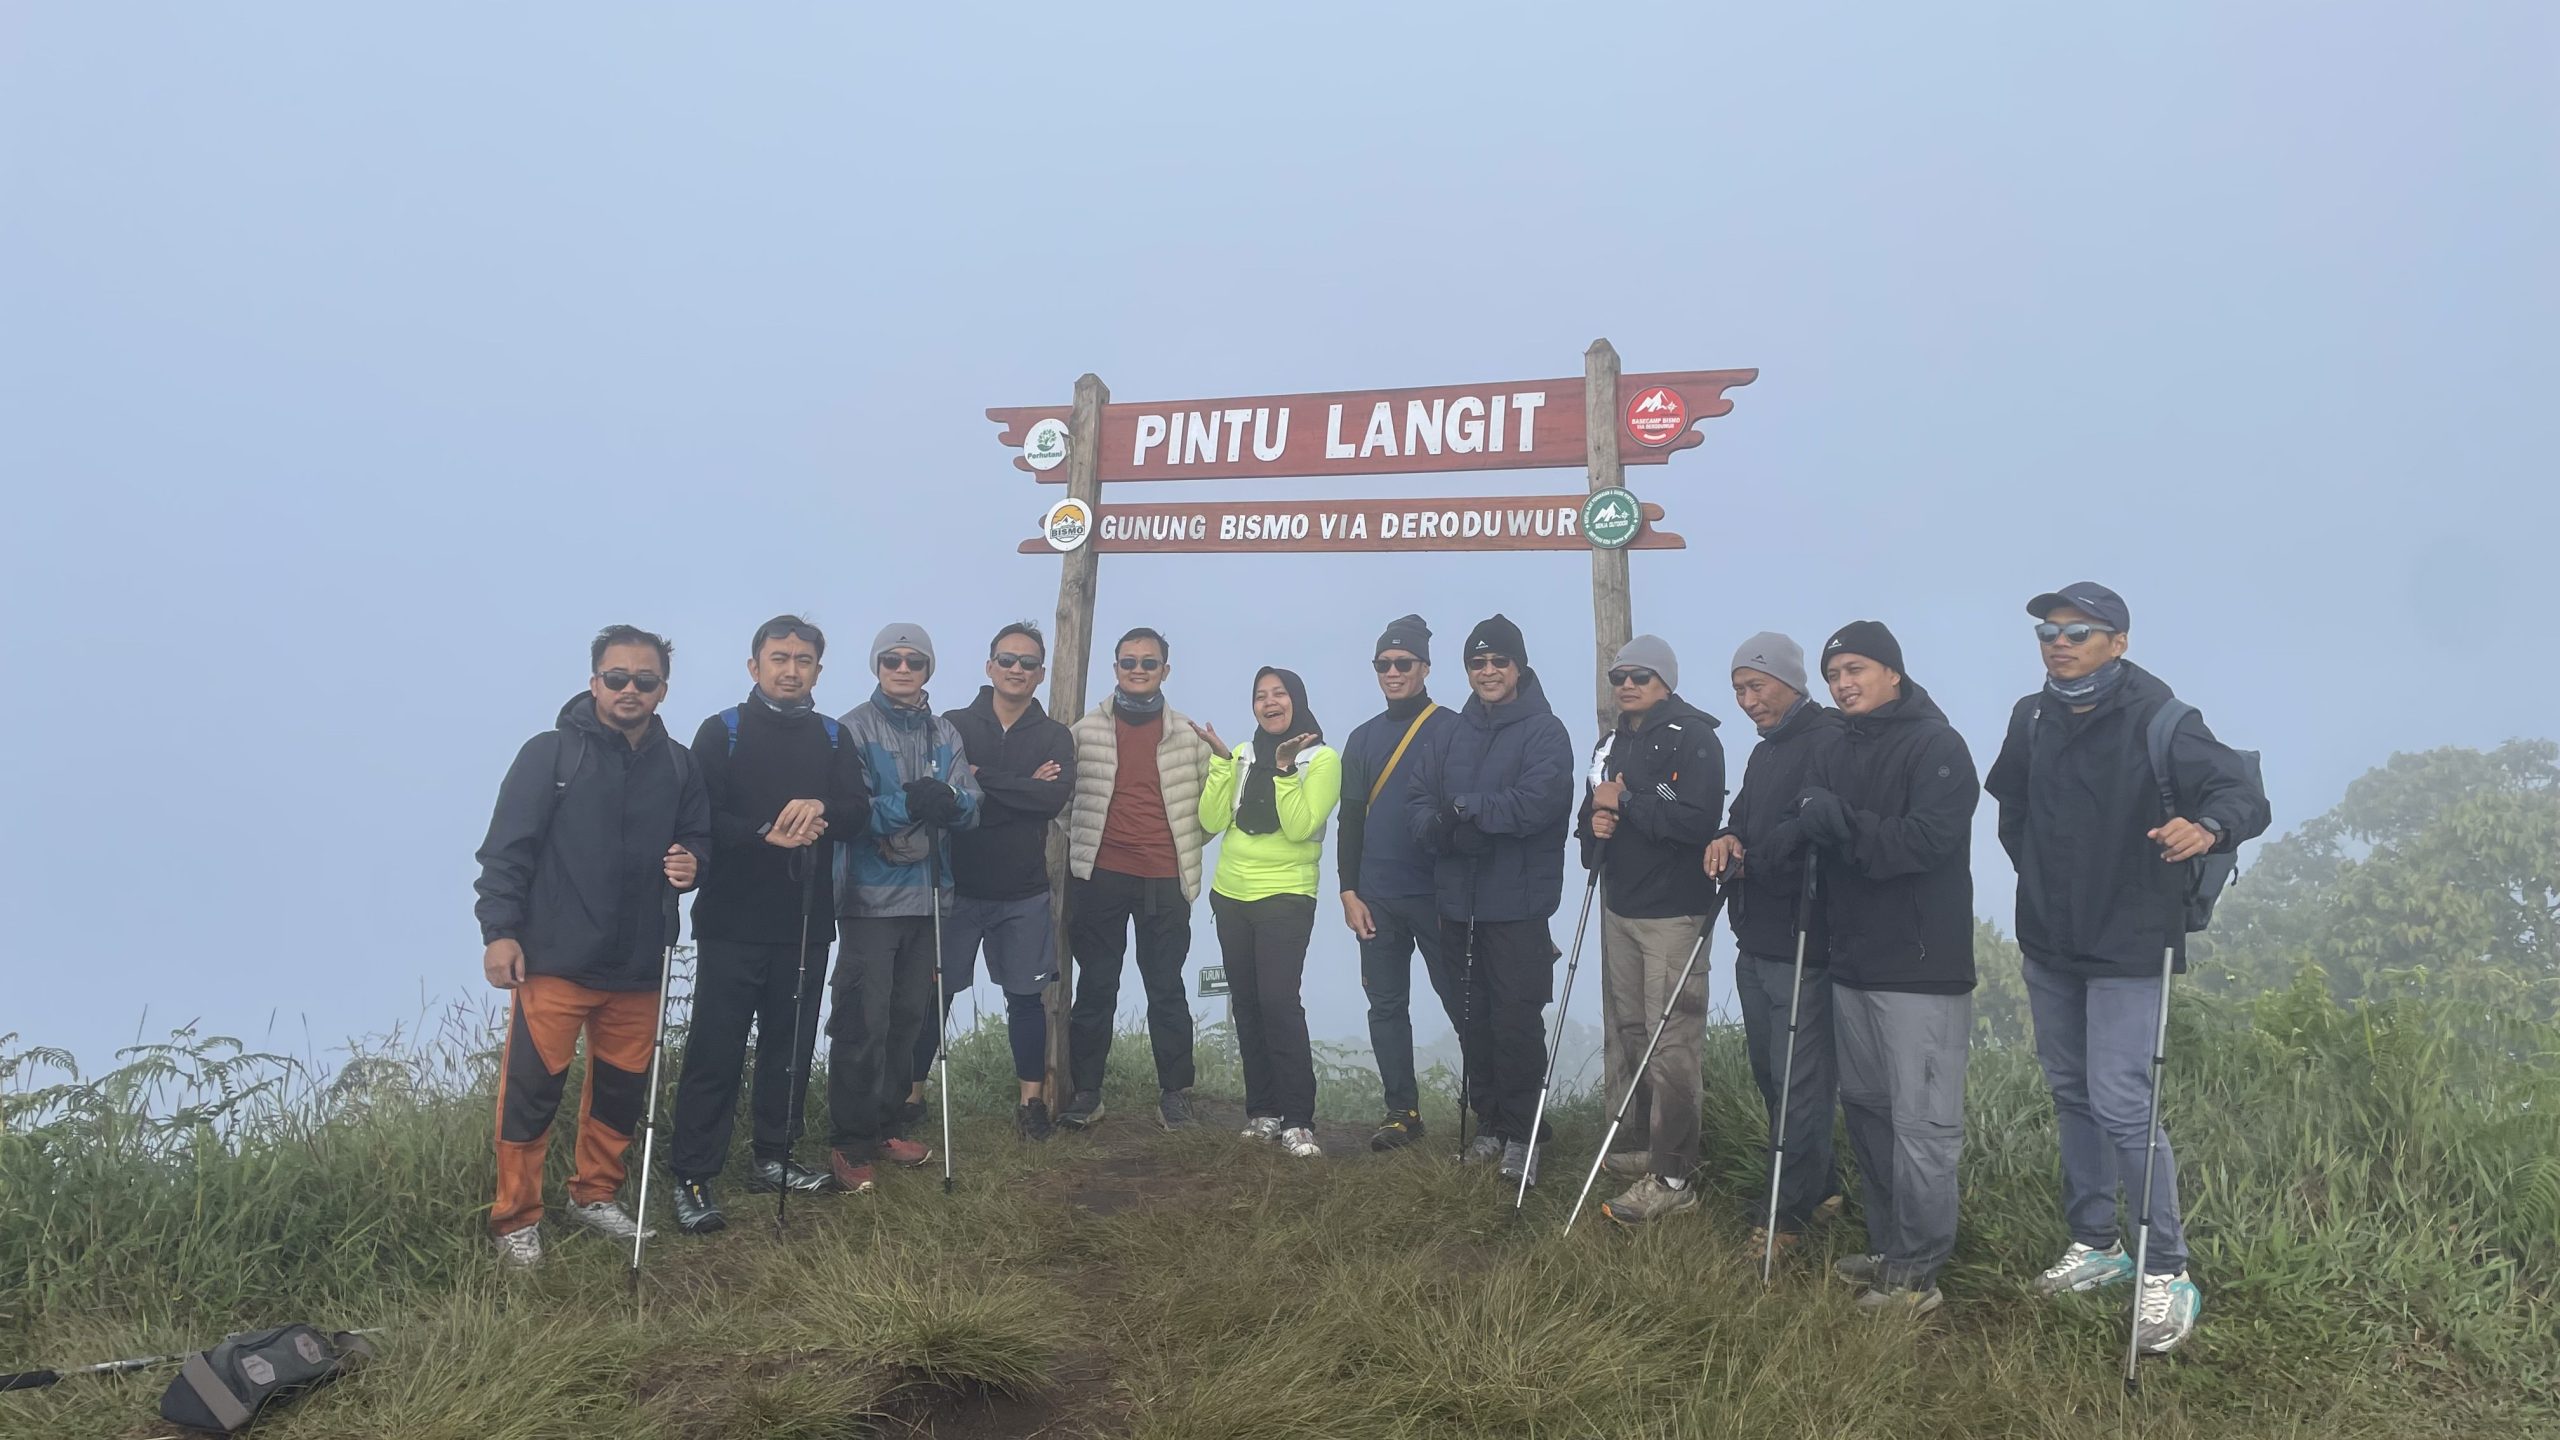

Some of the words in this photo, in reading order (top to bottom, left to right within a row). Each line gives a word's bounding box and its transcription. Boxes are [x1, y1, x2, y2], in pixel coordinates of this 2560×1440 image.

[1133, 407, 1290, 466] PINTU
[1325, 391, 1546, 459] LANGIT
[1027, 450, 1063, 460] Perhutani
[1100, 514, 1206, 541] GUNUNG
[1220, 513, 1310, 541] BISMO
[1320, 513, 1368, 540] VIA
[1380, 507, 1578, 538] DERODUWUR
[1051, 526, 1084, 538] BISMO
[1202, 969, 1221, 982] TURUN
